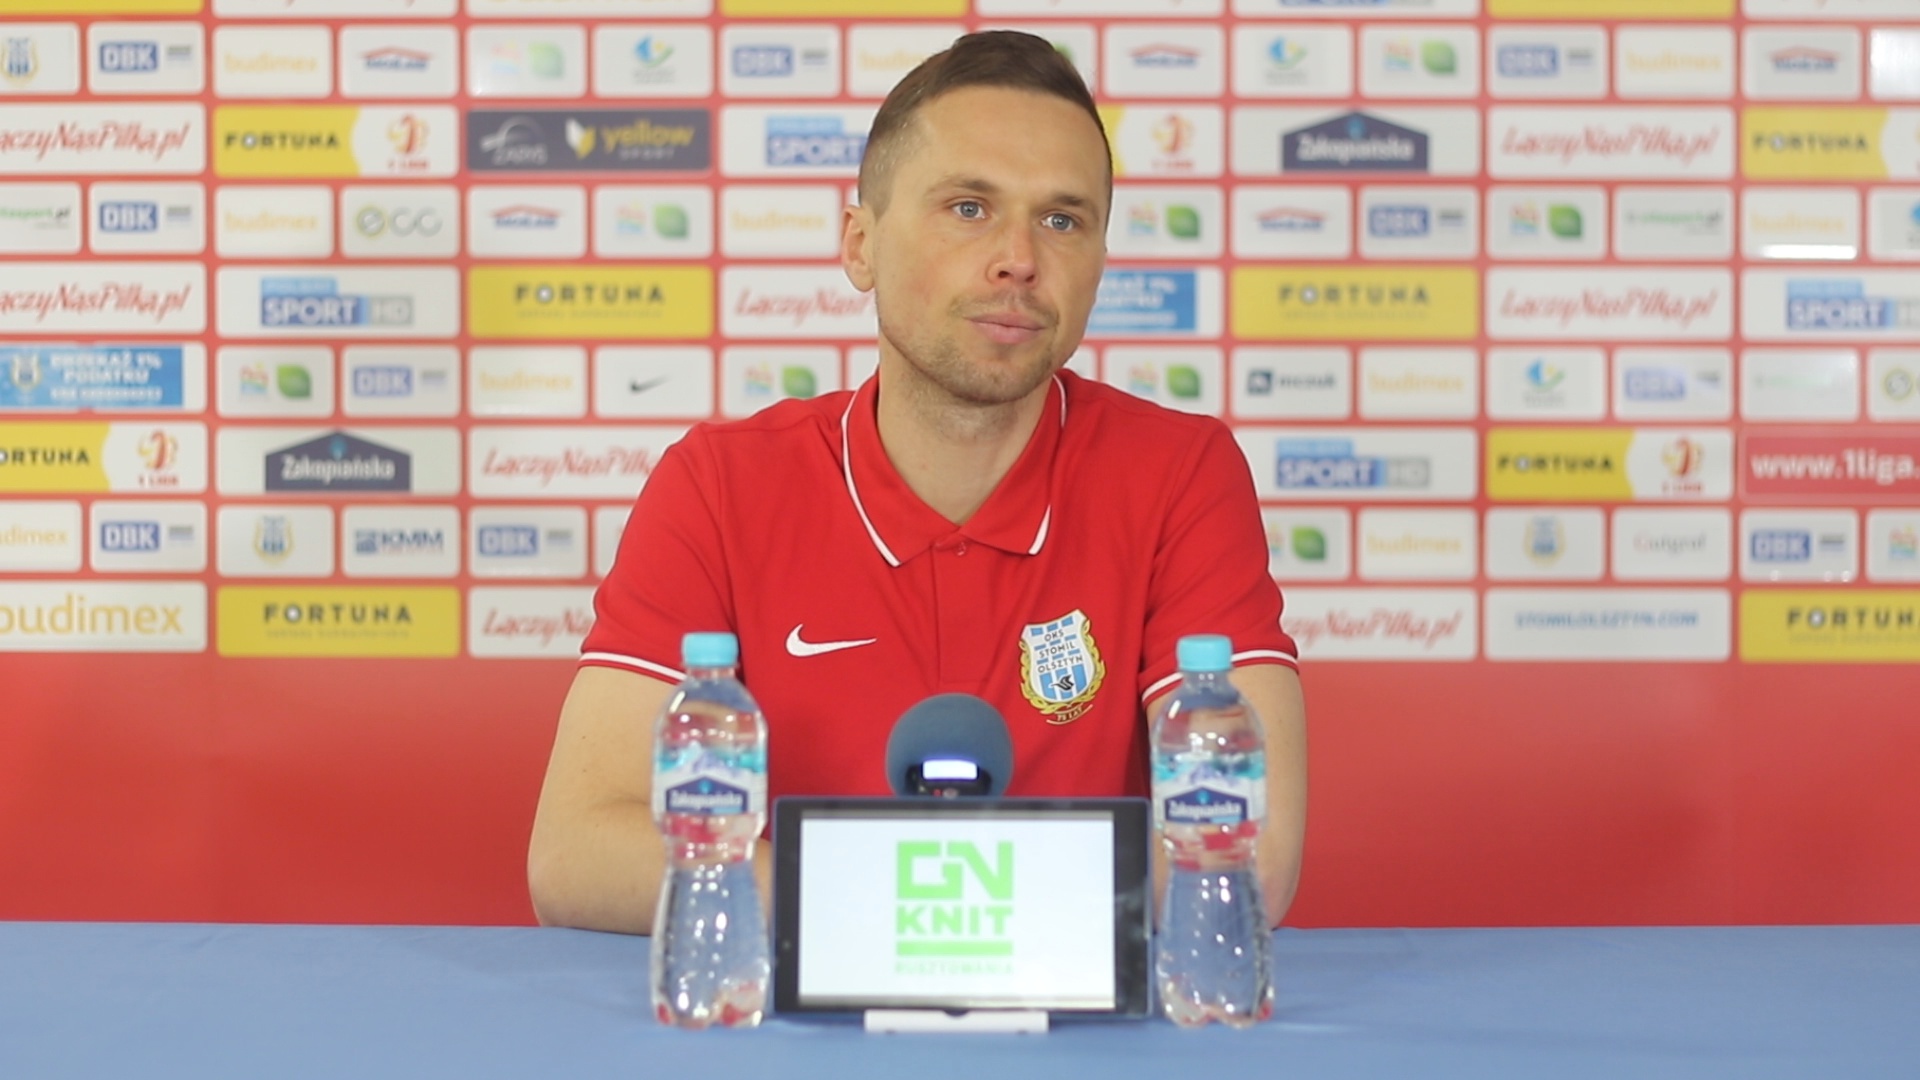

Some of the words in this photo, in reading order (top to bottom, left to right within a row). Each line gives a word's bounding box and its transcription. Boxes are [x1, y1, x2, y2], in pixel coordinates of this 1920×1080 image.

[102, 46, 155, 71] DBK
[225, 132, 341, 150] FORTUNA
[603, 120, 696, 158] yellow
[1752, 132, 1870, 151] FORTUNA
[102, 205, 155, 230] DBK
[515, 284, 664, 304] FORTUNA
[1278, 285, 1430, 306] FORTUNA
[263, 297, 357, 326] SPORT
[1788, 302, 1885, 330] SPORT
[354, 369, 410, 394] DBK
[0, 448, 90, 466] ORTUNA
[1497, 455, 1614, 473] FORTUNA
[1279, 458, 1374, 487] SPORT
[0, 524, 68, 546] dimex
[104, 524, 157, 550] DBK
[263, 604, 414, 625] FORTUNA
[1786, 608, 1920, 630] FORTUN
[1044, 628, 1064, 642] OKS
[1039, 641, 1075, 659] STOMIL
[1037, 655, 1083, 674] OLSZTYN
[896, 841, 1014, 900] GN
[896, 905, 1014, 936] KNIT
